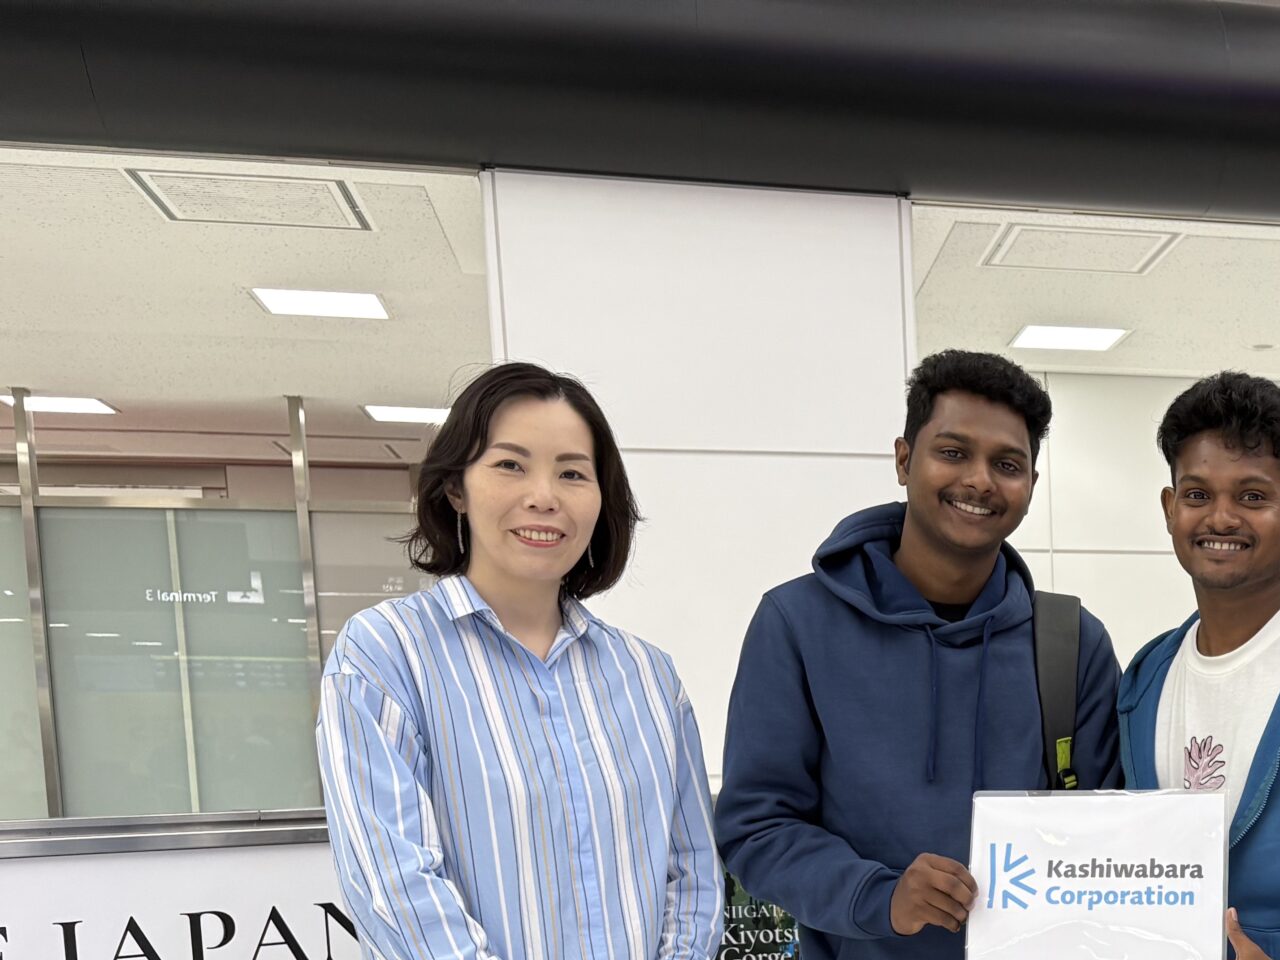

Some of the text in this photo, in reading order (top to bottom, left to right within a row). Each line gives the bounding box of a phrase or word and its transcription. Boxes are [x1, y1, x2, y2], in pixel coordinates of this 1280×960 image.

[1046, 858, 1204, 879] Kashiwabara
[1045, 885, 1195, 910] Corporation
[724, 904, 792, 919] NIIGAT
